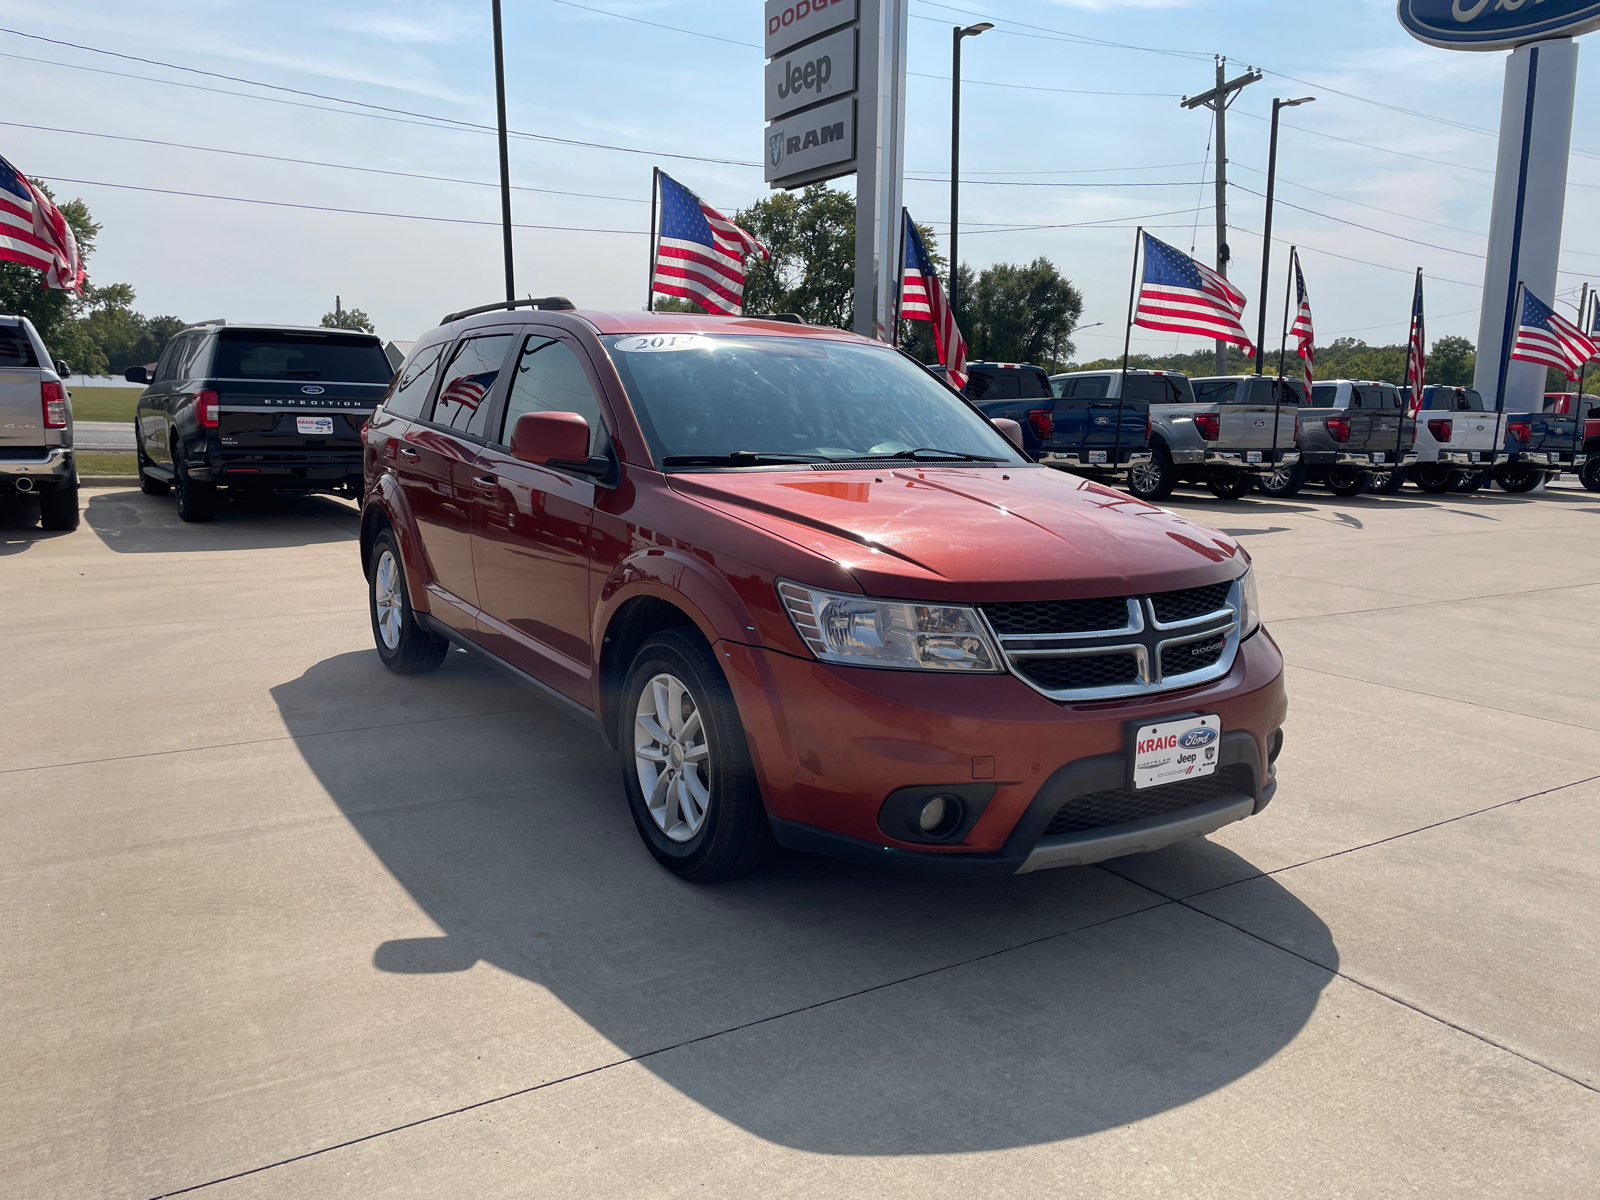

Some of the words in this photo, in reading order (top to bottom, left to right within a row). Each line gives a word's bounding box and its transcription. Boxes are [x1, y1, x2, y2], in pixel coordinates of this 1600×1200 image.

[769, 0, 844, 36] DODG
[778, 55, 832, 99] Jeep
[787, 121, 844, 155] RAM
[264, 399, 362, 407] EXPEDITION
[1192, 643, 1223, 655] DODGE
[1137, 734, 1178, 755] KRAIG
[1137, 758, 1171, 767] CHRYSLER
[1177, 753, 1197, 765] Jeep
[1157, 767, 1188, 778] DODGE
